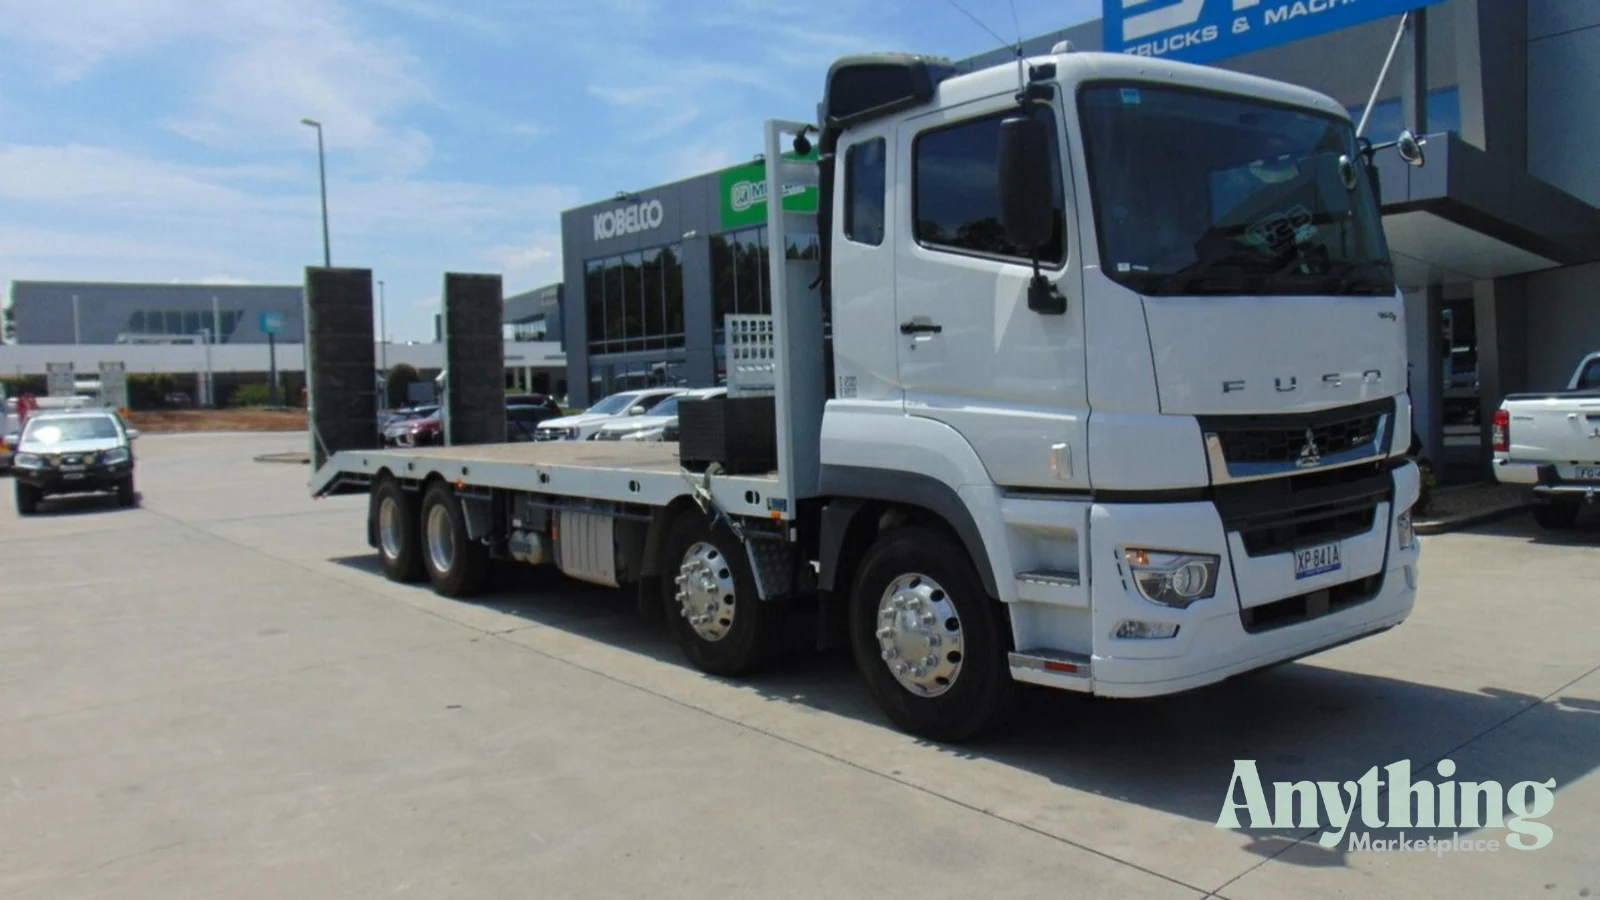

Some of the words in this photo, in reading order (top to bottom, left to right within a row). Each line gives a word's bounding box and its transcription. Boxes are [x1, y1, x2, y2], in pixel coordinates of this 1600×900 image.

[1124, 25, 1218, 56] TRUCKS
[1232, 16, 1250, 34] &
[593, 200, 664, 241] KOBELCO
[1222, 368, 1382, 394] FUSO
